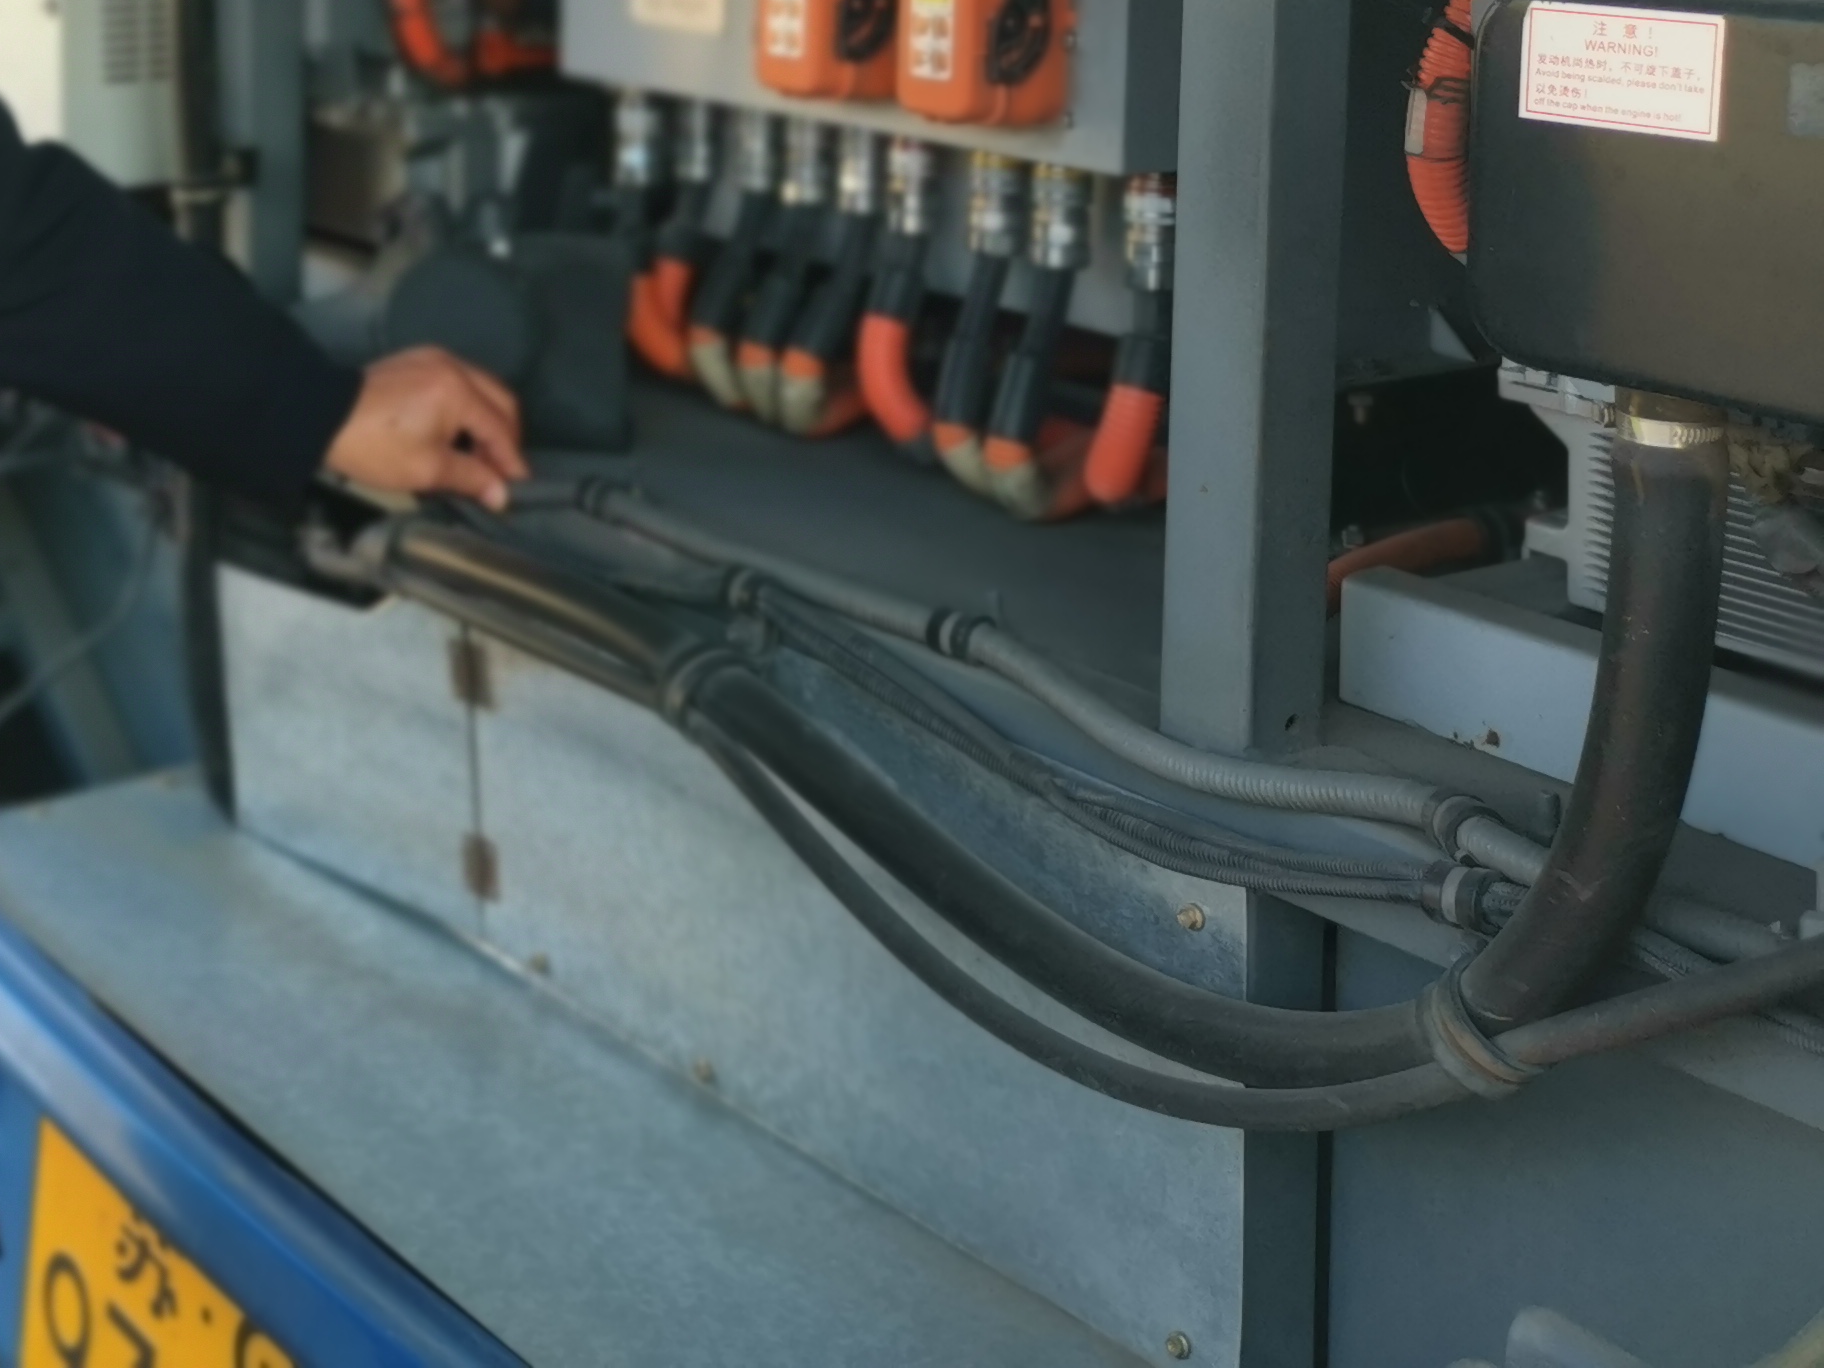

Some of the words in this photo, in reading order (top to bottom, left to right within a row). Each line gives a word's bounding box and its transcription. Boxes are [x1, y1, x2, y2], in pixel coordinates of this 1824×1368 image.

[1584, 39, 1659, 58] WARNING!
[1535, 67, 1560, 79] Avoid
[1561, 71, 1586, 83] being
[1626, 78, 1657, 89] please
[1684, 84, 1705, 95] take
[1534, 97, 1546, 106] off
[1546, 98, 1561, 108] the
[1562, 102, 1579, 112] cap
[1579, 103, 1604, 114] when
[1604, 106, 1620, 116] the
[1620, 108, 1652, 120] engine
[1653, 112, 1662, 121] is
